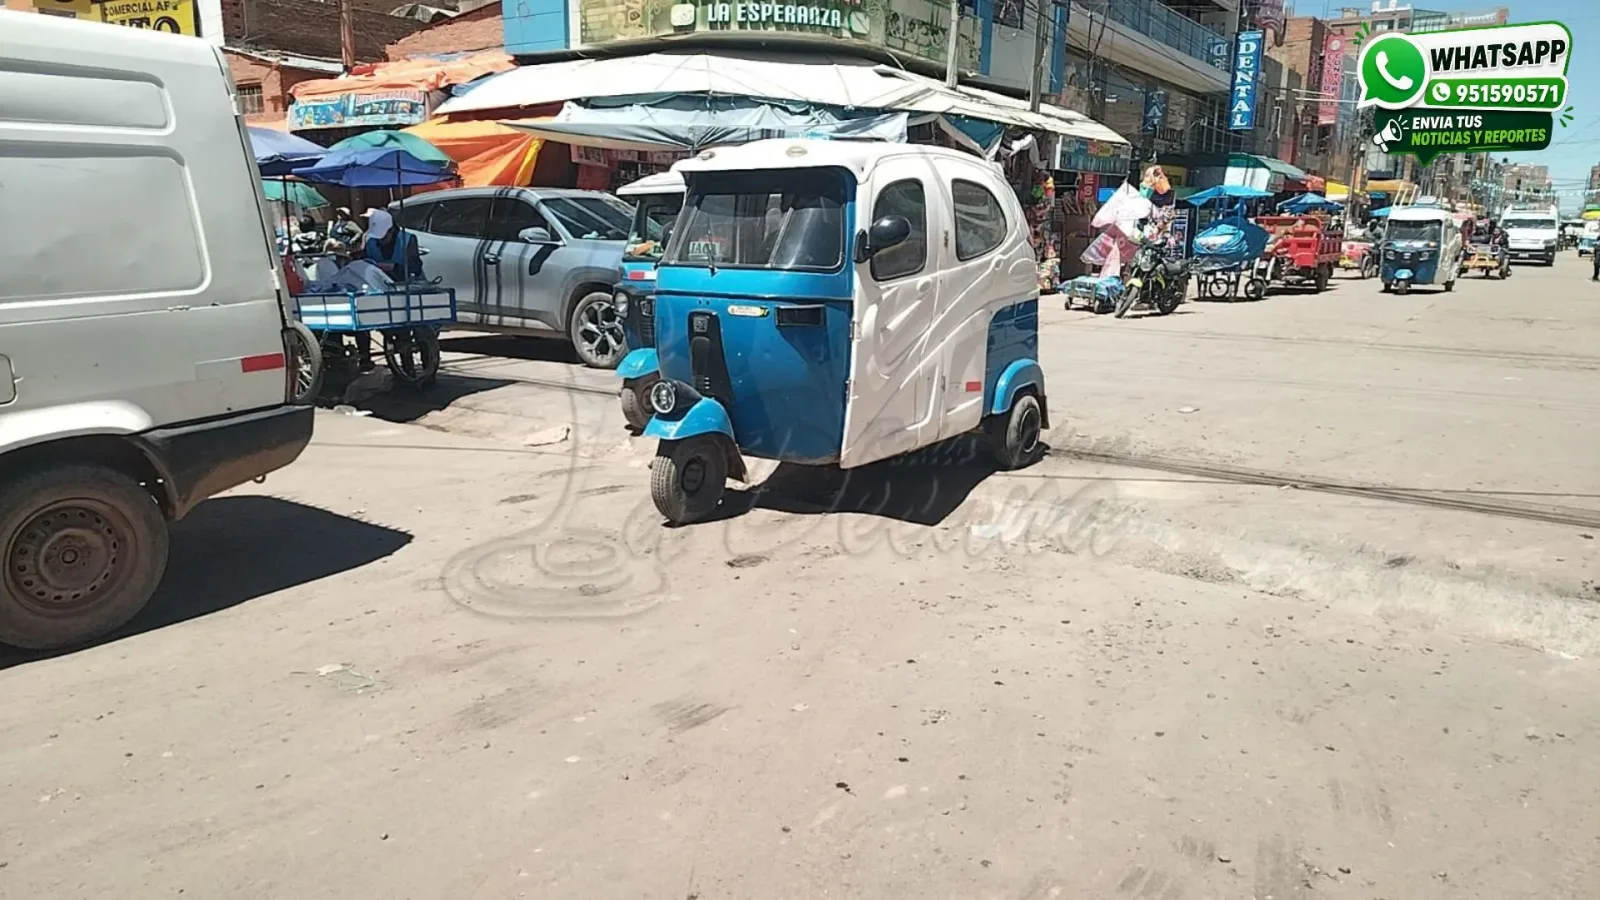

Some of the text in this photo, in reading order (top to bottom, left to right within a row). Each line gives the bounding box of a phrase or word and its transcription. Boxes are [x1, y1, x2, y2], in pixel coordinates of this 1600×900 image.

[104, 2, 154, 17] COMERCIAL
[708, 3, 842, 28] LA ESPERANZA
[1232, 41, 1257, 127] DENTAL
